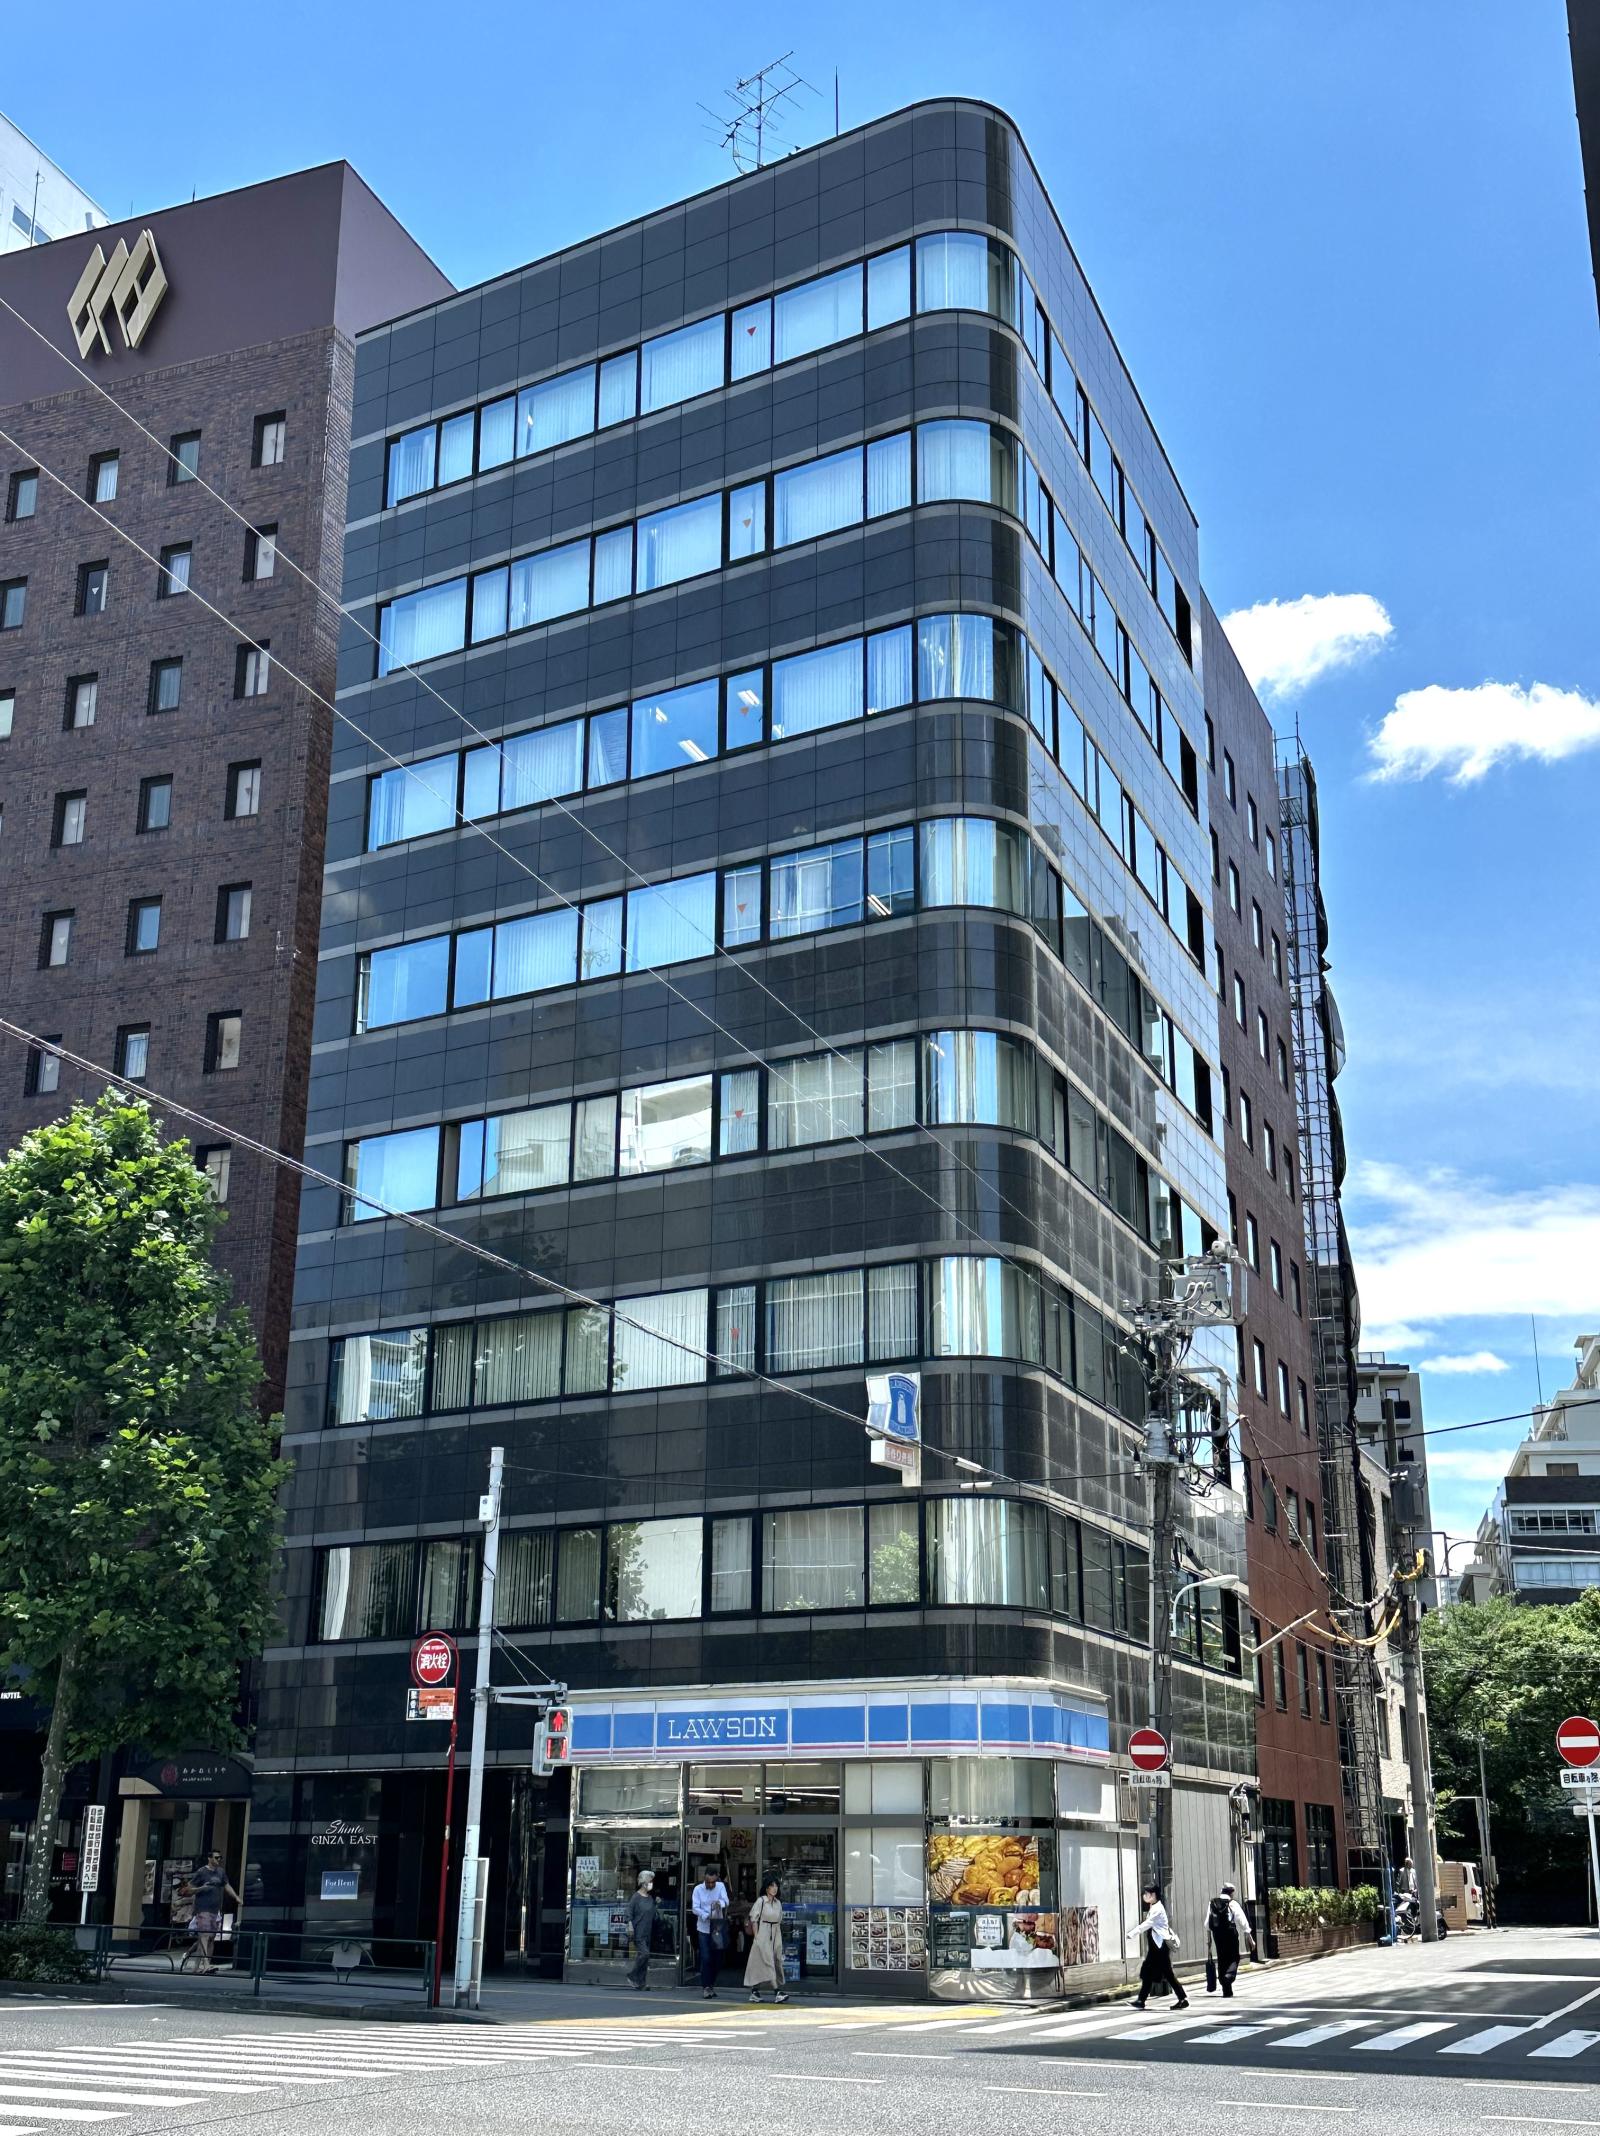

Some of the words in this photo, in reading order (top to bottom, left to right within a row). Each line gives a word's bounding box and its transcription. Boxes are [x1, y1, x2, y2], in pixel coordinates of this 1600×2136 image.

[420, 1653, 448, 1669] 消火栓
[668, 1716, 776, 1739] LAWSON
[1563, 1772, 1600, 1783] 自転車を除
[312, 1836, 344, 1845] GINZA
[349, 1835, 379, 1845] EAST
